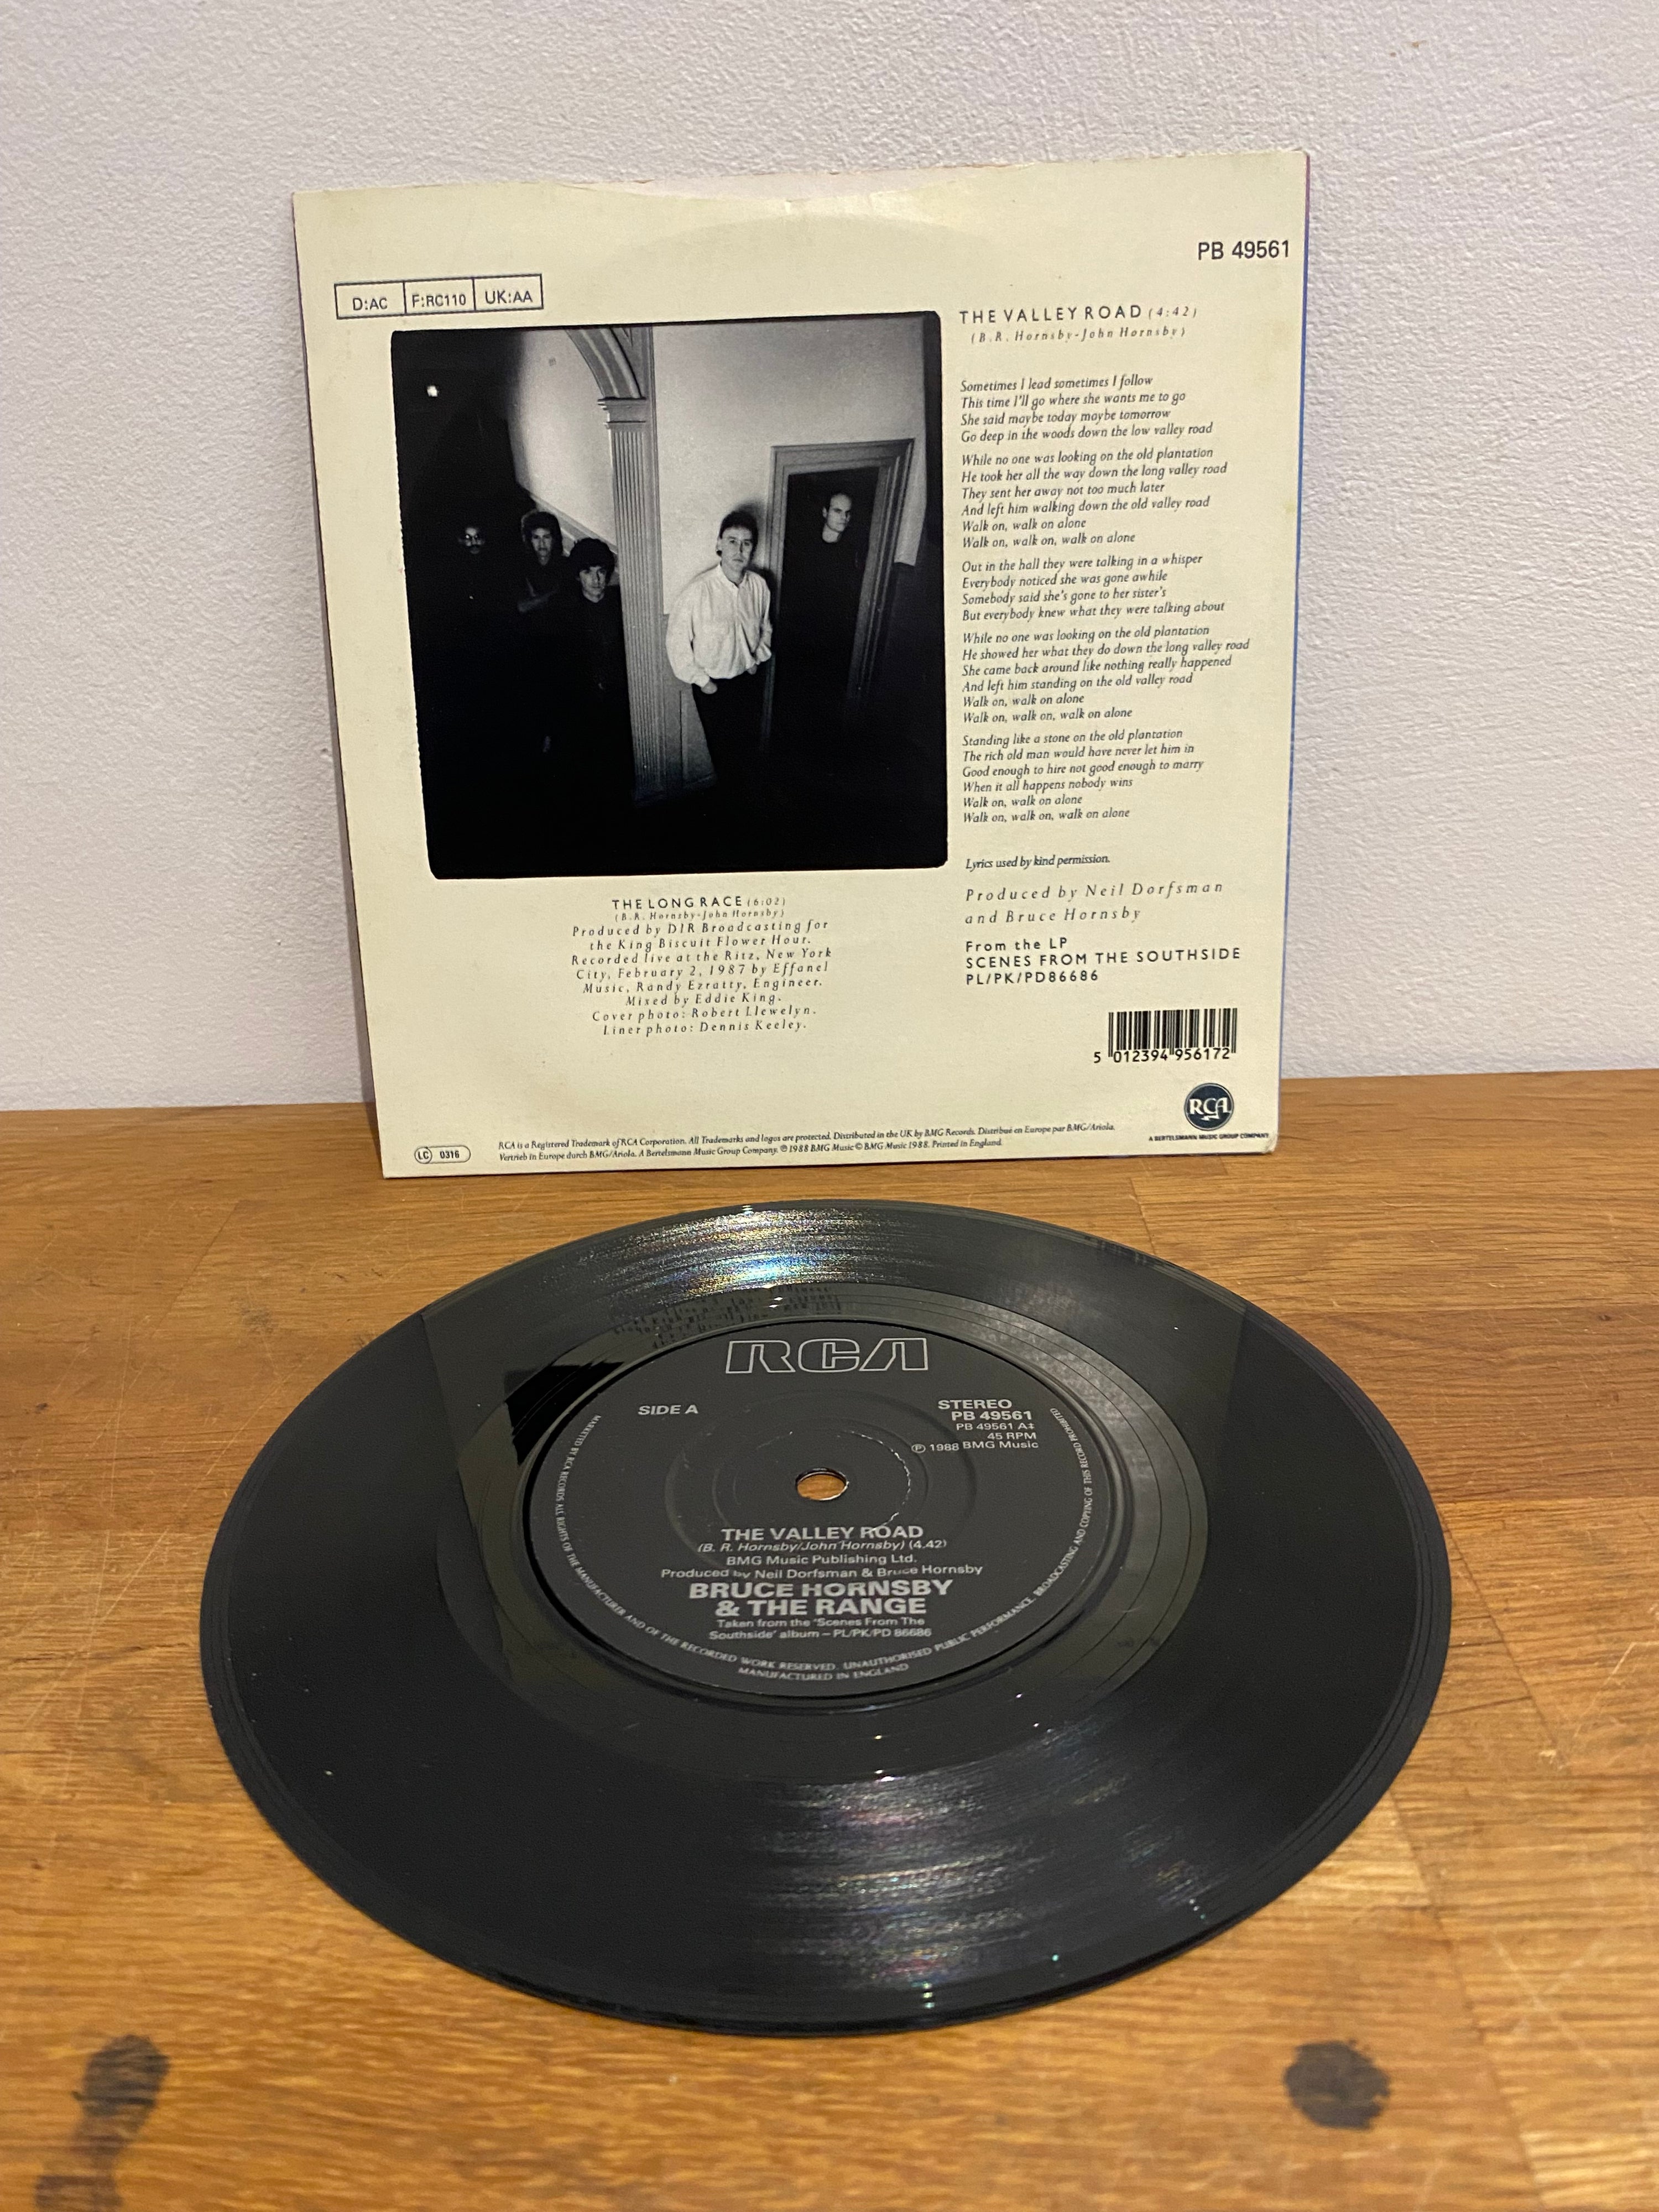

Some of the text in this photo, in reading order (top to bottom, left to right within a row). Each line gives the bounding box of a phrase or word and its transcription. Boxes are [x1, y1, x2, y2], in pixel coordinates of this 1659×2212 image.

[1198, 239, 1288, 260] PB 49561
[352, 290, 533, 310] D:AC F:RC110 UK:AA
[958, 304, 1196, 324] THE VALLEY ROAD (4:42)
[959, 373, 1153, 392] Sometimes I lead sometimes I follow
[961, 396, 983, 409] This
[987, 397, 1010, 408] time
[1031, 397, 1045, 411] go
[1049, 393, 1080, 405] where
[1082, 392, 1100, 404] she
[1104, 394, 1136, 403] wants
[1139, 394, 1155, 402] me
[1158, 393, 1169, 401] to
[1171, 393, 1186, 405] go
[960, 408, 1171, 427] She said maybe today maybe tomorrow
[961, 421, 1213, 445] Go deep in the woods down the low valley road
[965, 854, 1110, 872] Lyrics used by kind permission.
[966, 880, 1222, 901] Produced by Neil Dorfsman
[611, 899, 641, 909] THE
[648, 897, 693, 909] LONG
[700, 895, 742, 907] RACE
[964, 906, 1140, 924] and Bruce Hornsby
[966, 937, 1067, 952] From the LP
[966, 947, 1240, 968] SCENES FROM THE SOUTHSIDE
[966, 969, 1098, 984] PL/PK/PD86686
[625, 991, 781, 1007] Mixed by Eddie King.
[592, 1004, 816, 1024] Cover photo: Robert Llewelyn.
[603, 1018, 806, 1037] Liner photo: Dennis Keeley.
[1094, 1048, 1230, 1063] 5 012394 956172
[1189, 1098, 1231, 1115] RCA
[531, 1140, 569, 1150] Registered
[612, 1139, 622, 1148] of
[418, 1150, 459, 1160] LC 0316
[726, 1338, 928, 1374] RCA
[638, 1405, 698, 1415] SIDE A
[938, 1399, 1012, 1409] STEREO
[952, 1411, 1031, 1421] PB 49561
[721, 1525, 924, 1541] THE VALLEY ROAD
[720, 1543, 733, 1552] R.
[738, 1540, 836, 1552] Hornsby/John
[840, 1540, 905, 1551] Hornsby)
[726, 1554, 917, 1566] BMG Music Publishing Ltd.
[661, 1564, 983, 1579] Produced by Neil Dorfsman & Bruce Hornsby
[689, 1579, 953, 1599] BRUCE HORNSBY
[715, 1598, 927, 1616] & THE RANGE
[717, 1619, 754, 1628] Taken
[757, 1618, 787, 1627] from
[790, 1618, 811, 1627] the
[865, 1617, 898, 1625] From
[900, 1617, 925, 1625] The
[738, 1667, 833, 1681] MANUFACTURED
[853, 1663, 910, 1679] ENGLAND
